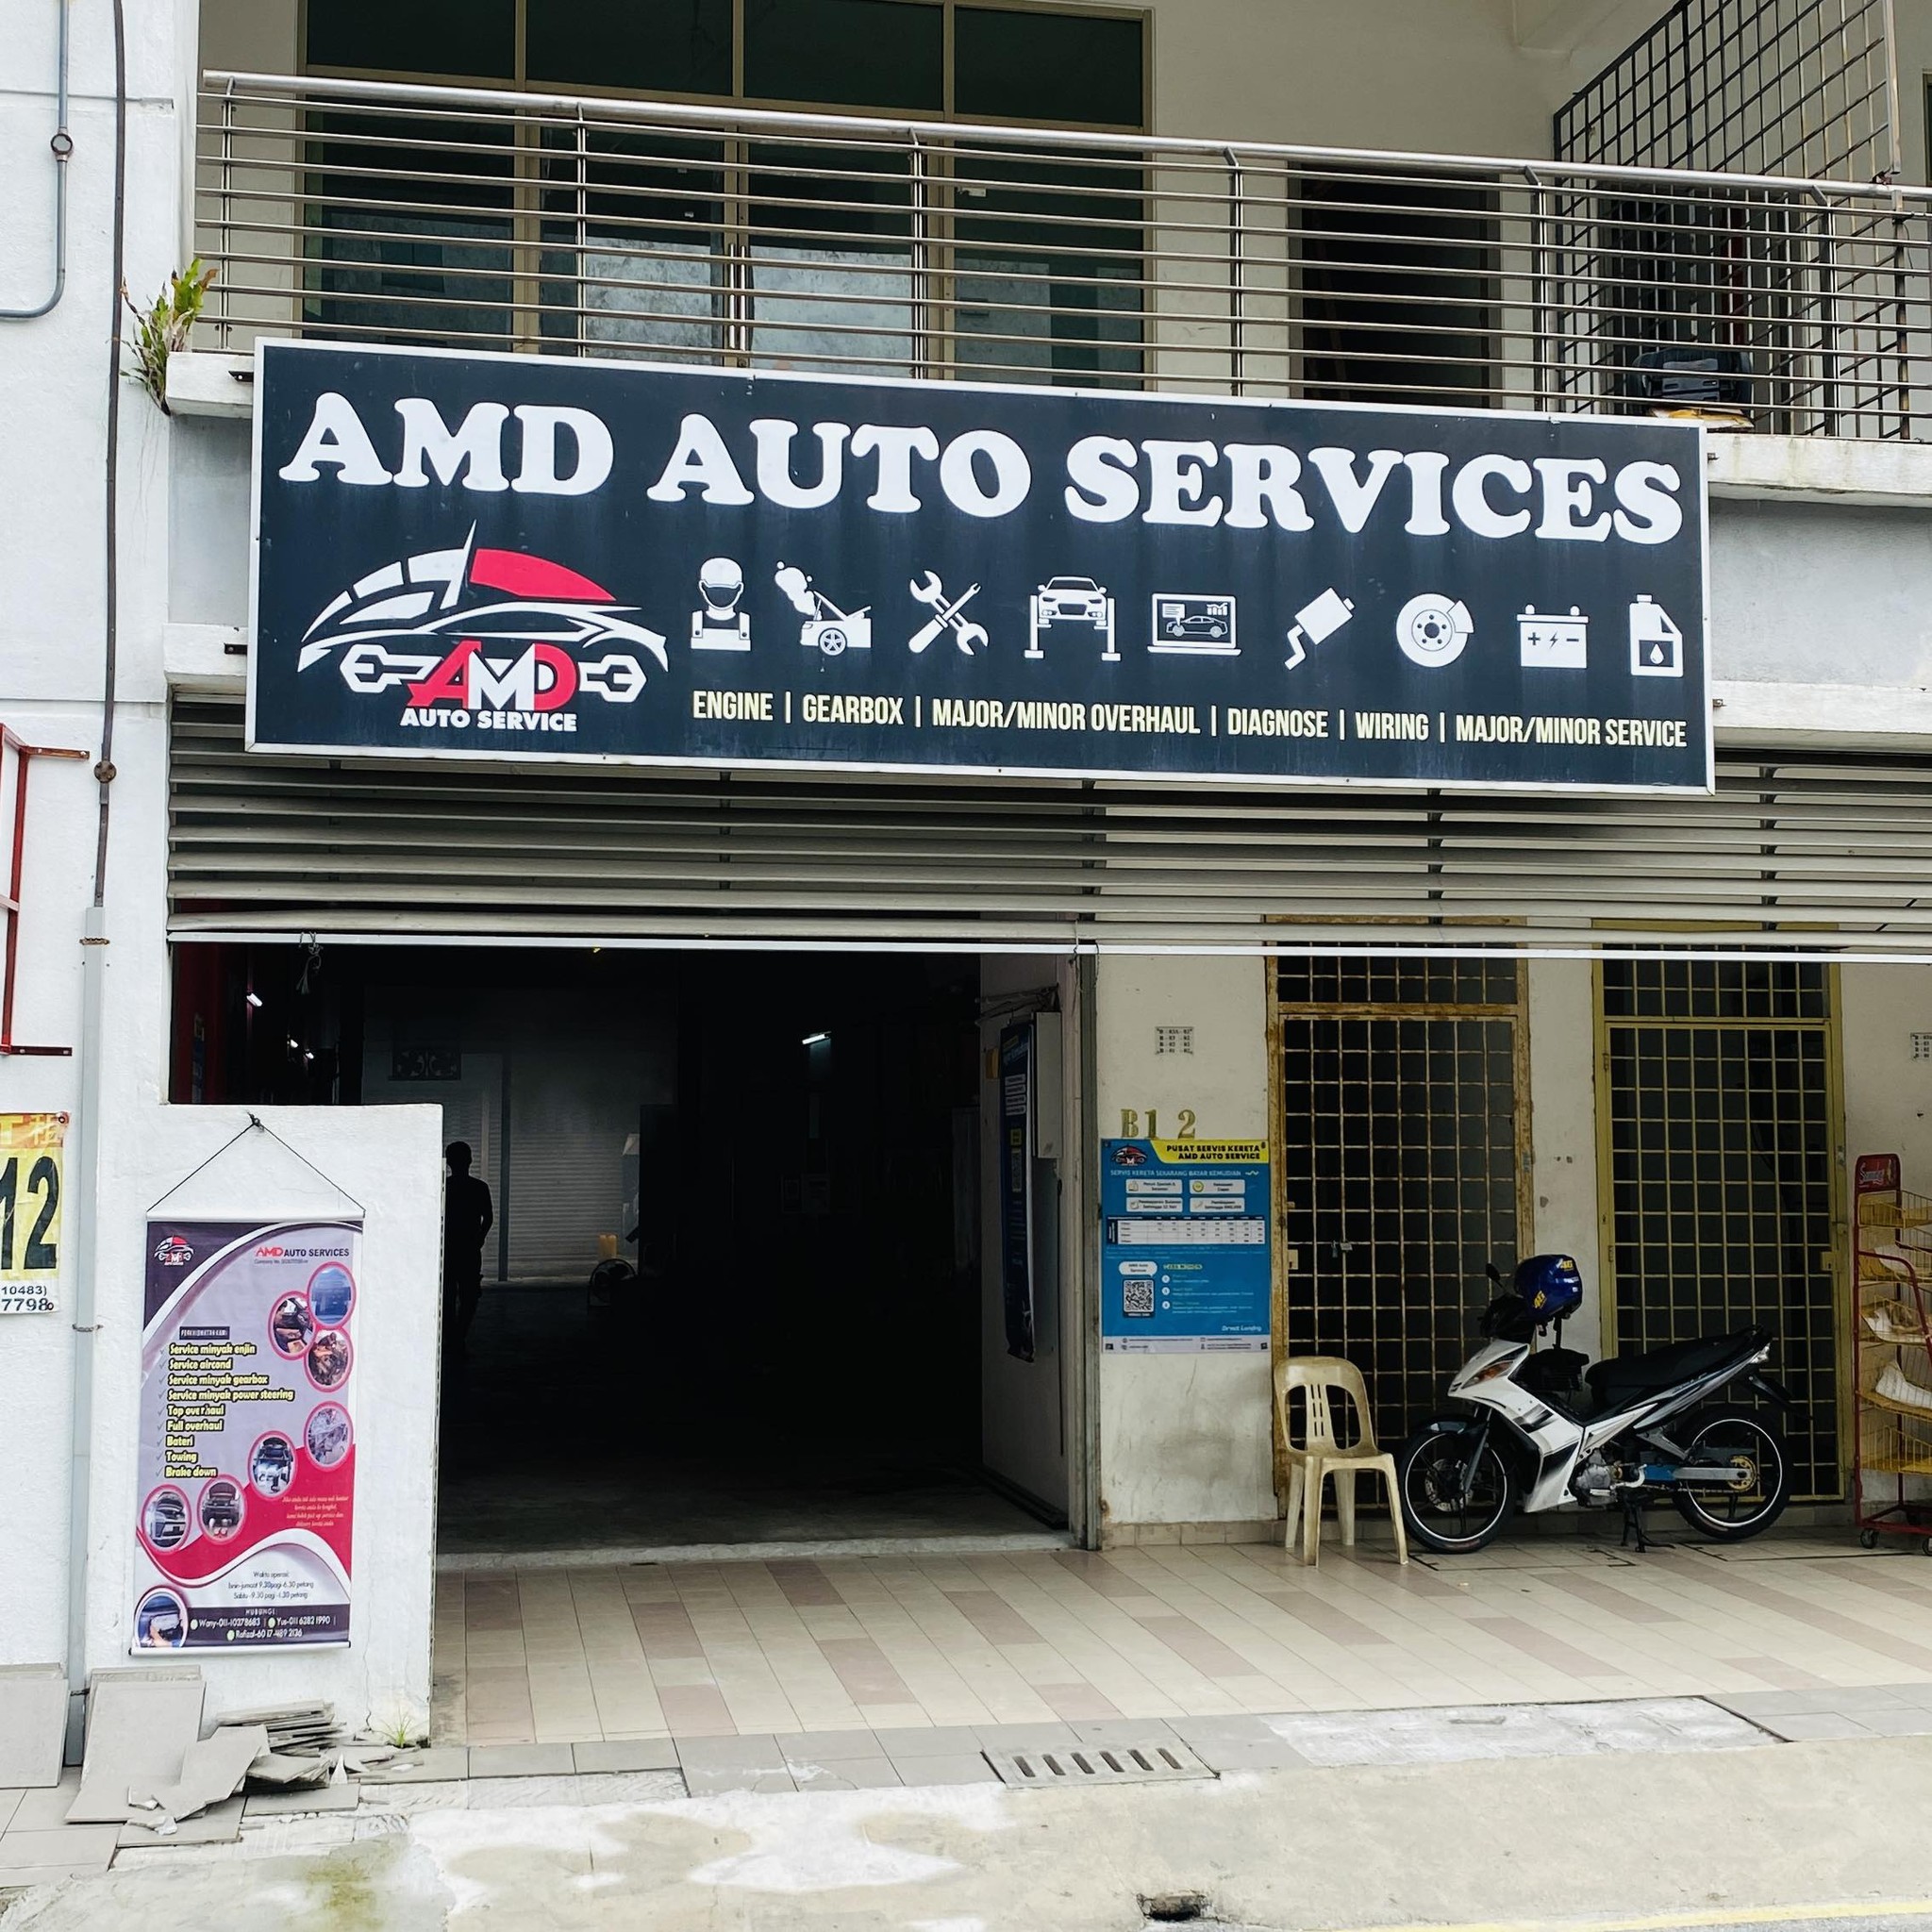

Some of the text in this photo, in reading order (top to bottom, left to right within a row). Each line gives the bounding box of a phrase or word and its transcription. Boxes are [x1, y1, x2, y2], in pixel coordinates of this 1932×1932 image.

[279, 391, 1684, 544] AMD AUTO SERVICES
[407, 640, 578, 712] AMD
[400, 708, 578, 732] AUTO SERVICE
[692, 690, 1688, 748] ENGINE GEARBOX MAJOR/MINOR OVERHAUL DIAGNOSE WIRING MAJOR/MINOR SERVICE
[1166, 1144, 1260, 1153] PUSAT SERVIS KERETA
[255, 1246, 350, 1257] AMD AUTO SERVICES
[169, 1342, 256, 1357] Service minyak enjin
[169, 1358, 232, 1371] Service aircond
[168, 1374, 269, 1387] Service minyak gearbox
[167, 1390, 294, 1403] Service minyak power steering
[167, 1404, 184, 1418] Top
[167, 1419, 225, 1431] Full overhaul
[165, 1435, 194, 1448] Bateri
[165, 1451, 198, 1464] Towing
[164, 1466, 217, 1478] Brake down
